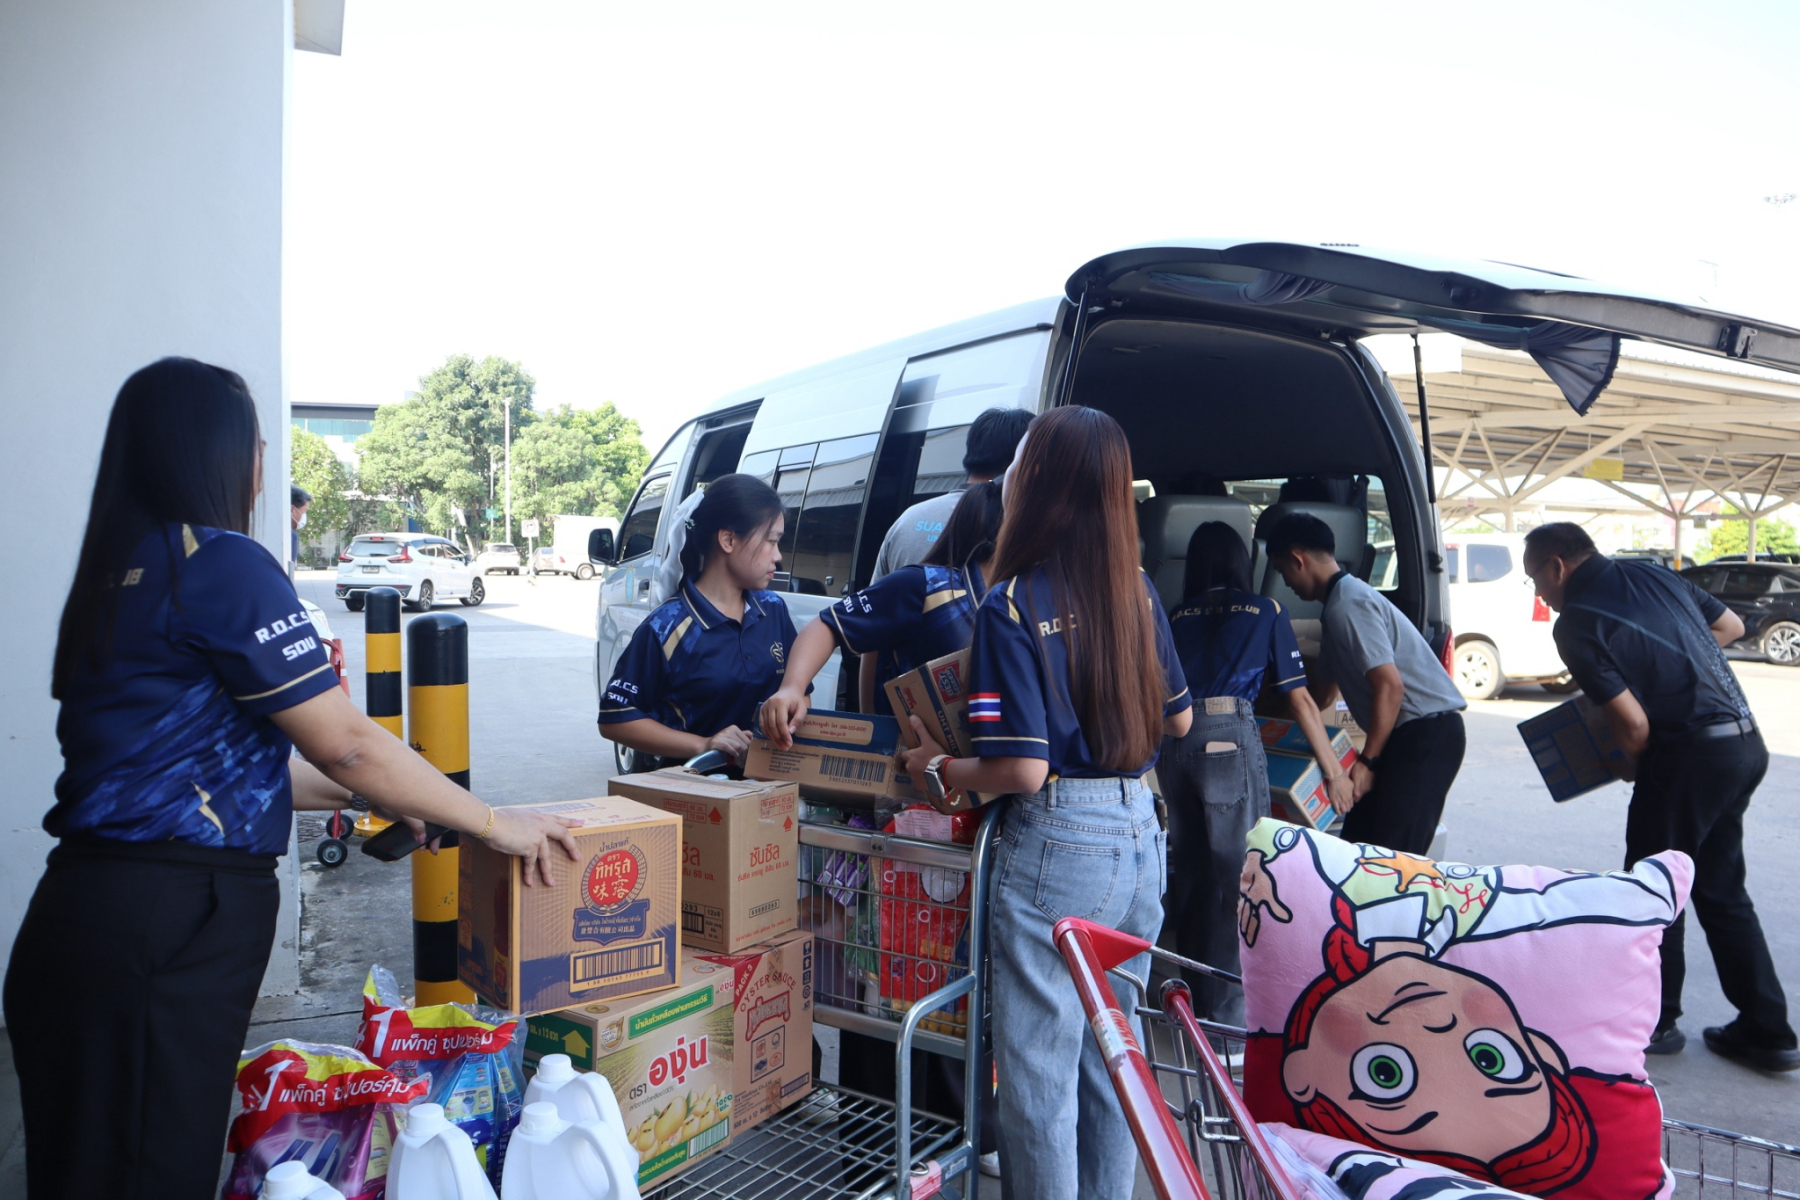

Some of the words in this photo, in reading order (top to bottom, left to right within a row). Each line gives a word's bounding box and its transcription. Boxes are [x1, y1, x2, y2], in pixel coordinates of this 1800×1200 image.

[914, 520, 944, 532] SUA
[1230, 605, 1260, 615] CLUB
[282, 636, 318, 661] SDU
[939, 672, 954, 696] BEST
[937, 710, 949, 732] UHT
[599, 836, 630, 853] น้ำปลาแท้
[750, 843, 781, 868] ซันซิล
[606, 853, 620, 862] ตรา
[595, 857, 632, 881] ทิพรส
[693, 869, 702, 879] 60
[719, 979, 734, 993] องุ่น
[735, 971, 749, 997] PACK
[740, 973, 770, 1012] OYSTER
[772, 971, 797, 990] SAUCE
[390, 1033, 438, 1055] แพ็กคู่
[648, 1035, 710, 1087] องุ่น
[278, 1083, 327, 1107] แพ็กคู่
[629, 1083, 647, 1100] ตรา
